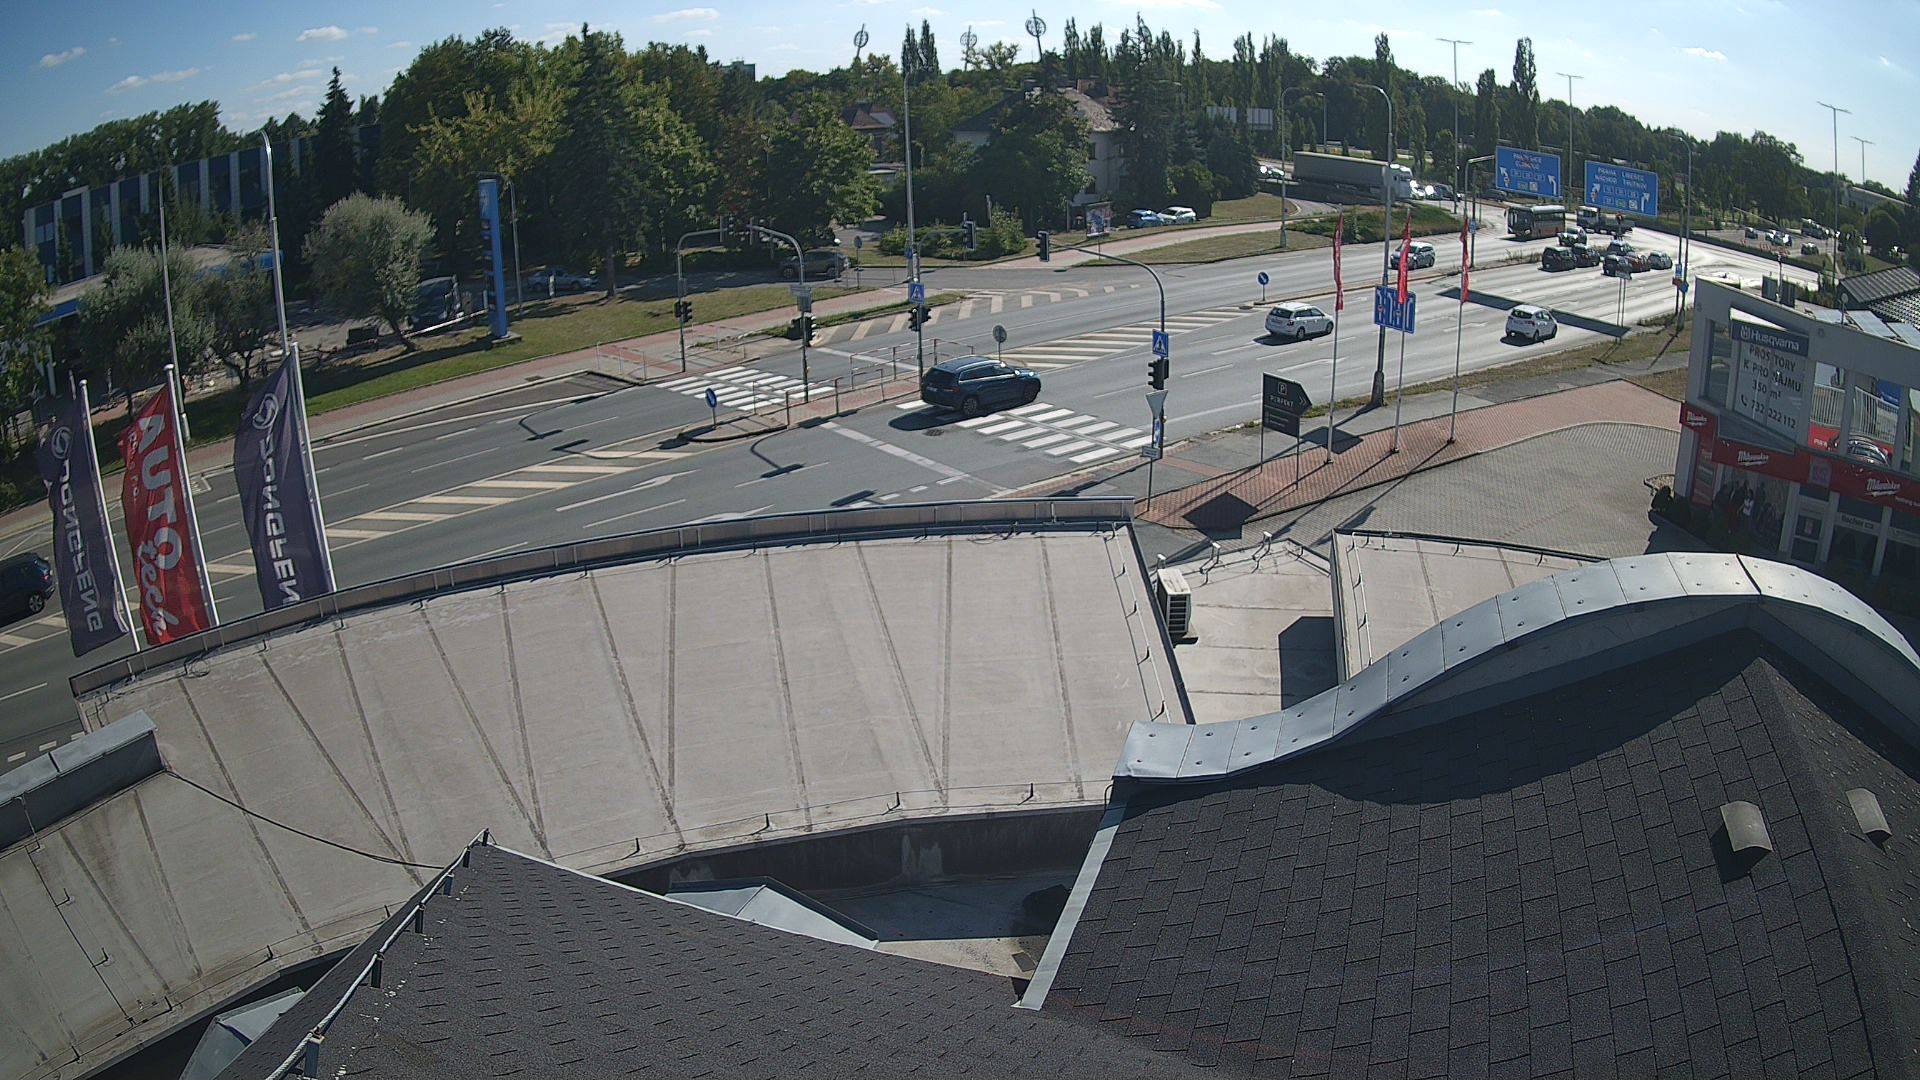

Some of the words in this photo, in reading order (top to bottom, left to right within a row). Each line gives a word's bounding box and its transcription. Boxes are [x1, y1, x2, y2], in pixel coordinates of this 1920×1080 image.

[1751, 329, 1799, 351] Husqvarna
[1743, 359, 1749, 369] K
[136, 414, 183, 570] AUTO
